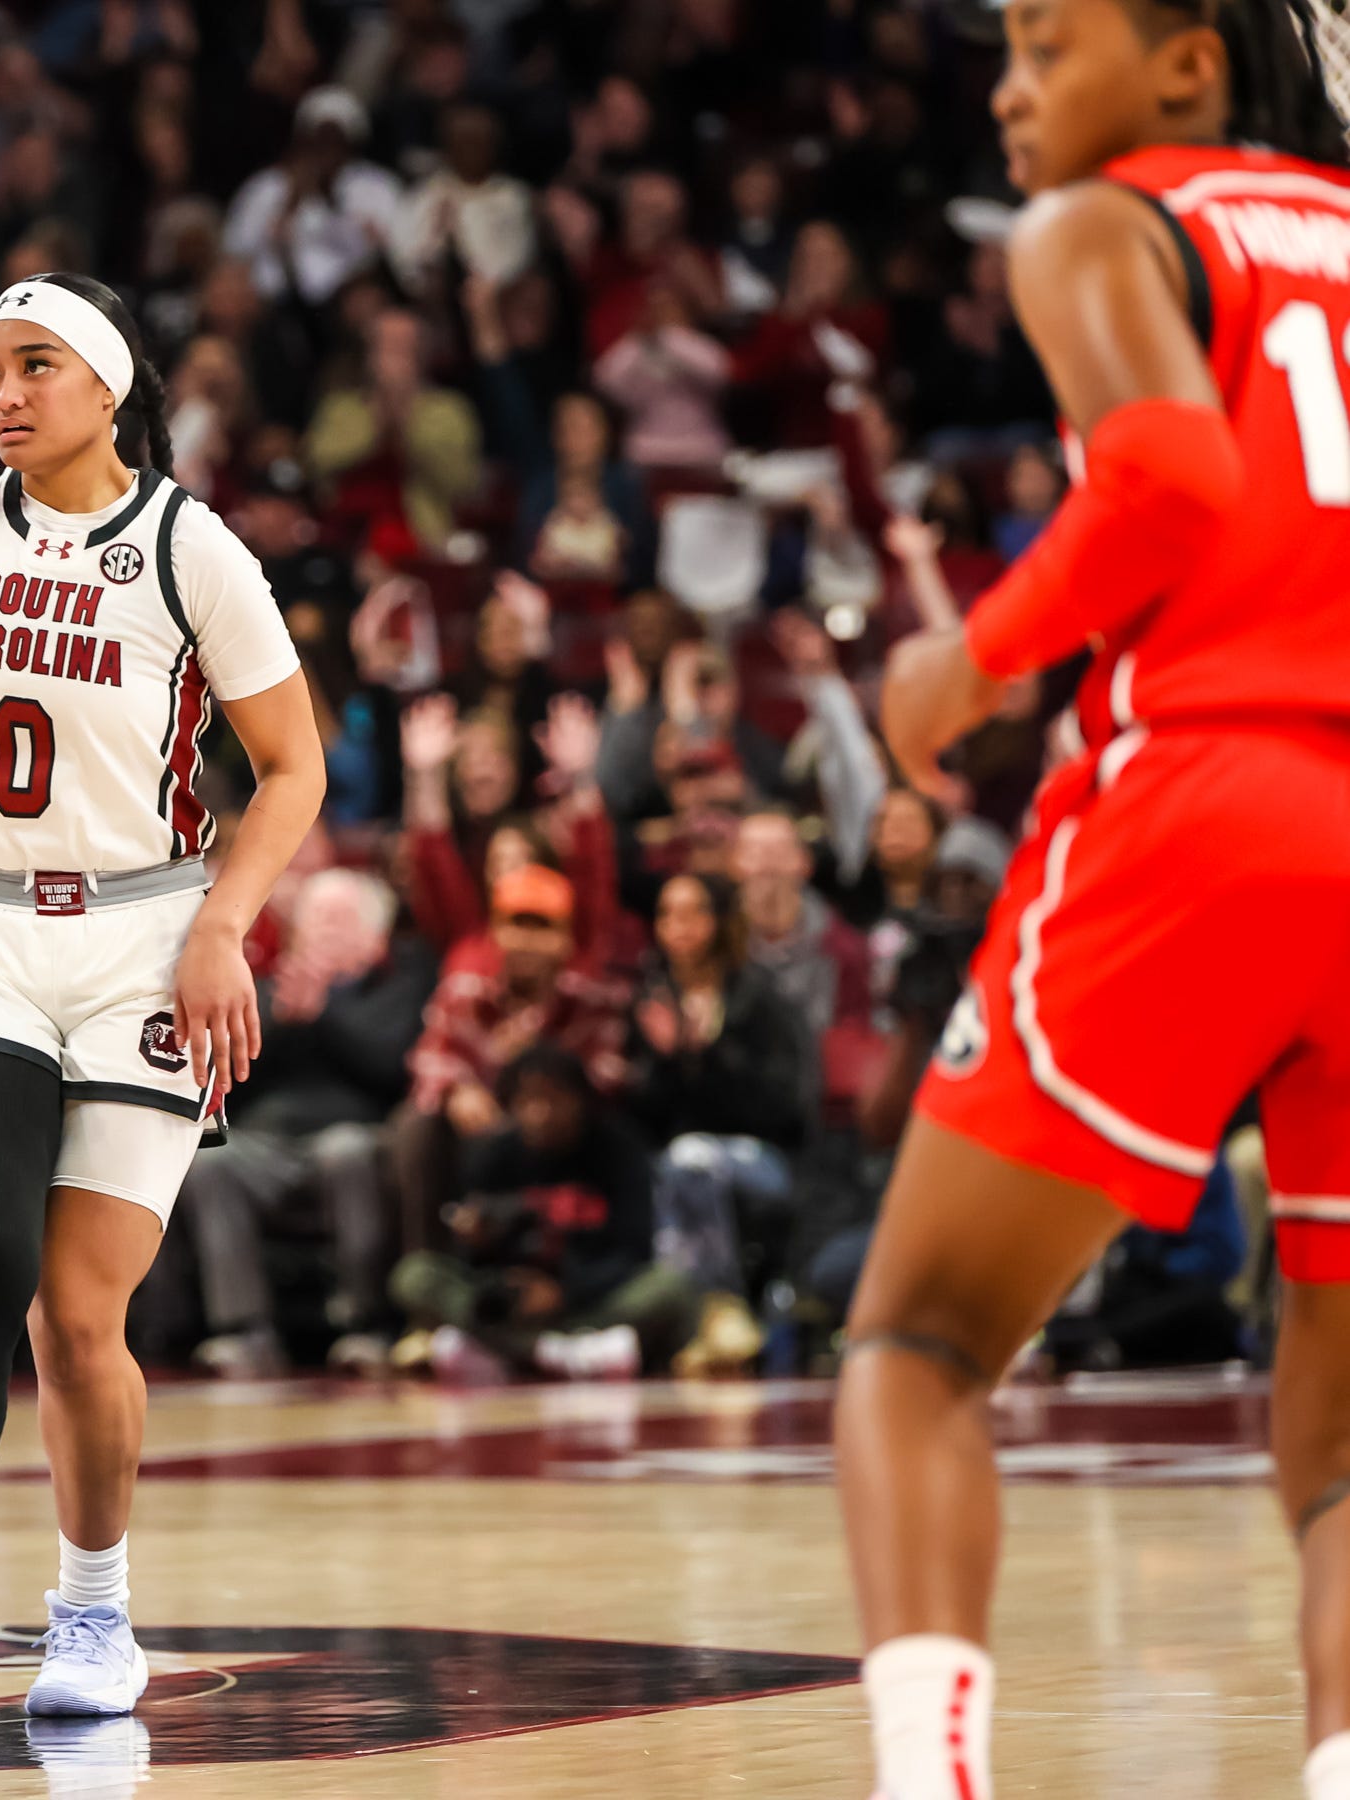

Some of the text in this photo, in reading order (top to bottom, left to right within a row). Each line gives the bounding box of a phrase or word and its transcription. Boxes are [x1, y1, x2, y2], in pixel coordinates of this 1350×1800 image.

[103, 545, 141, 581] SEC
[39, 883, 78, 894] CAROLINA
[46, 894, 72, 904] SOUTH
